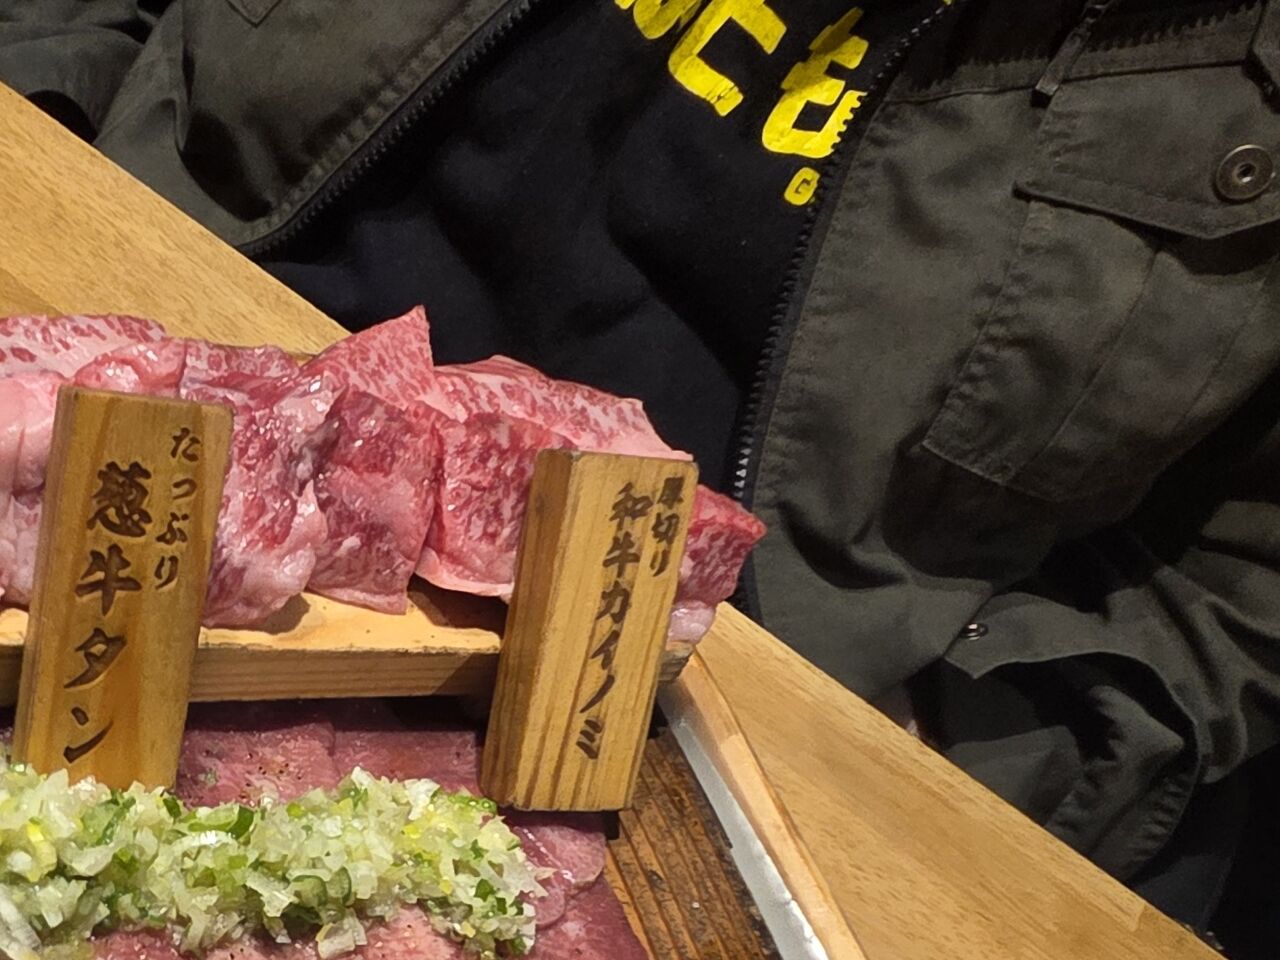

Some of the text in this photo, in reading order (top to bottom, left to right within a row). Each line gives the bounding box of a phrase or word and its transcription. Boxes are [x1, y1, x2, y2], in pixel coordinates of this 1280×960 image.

[63, 460, 152, 764] 葱牛タン
[576, 482, 654, 760] 和牛カイノミ
[650, 476, 686, 577] 厚切り
